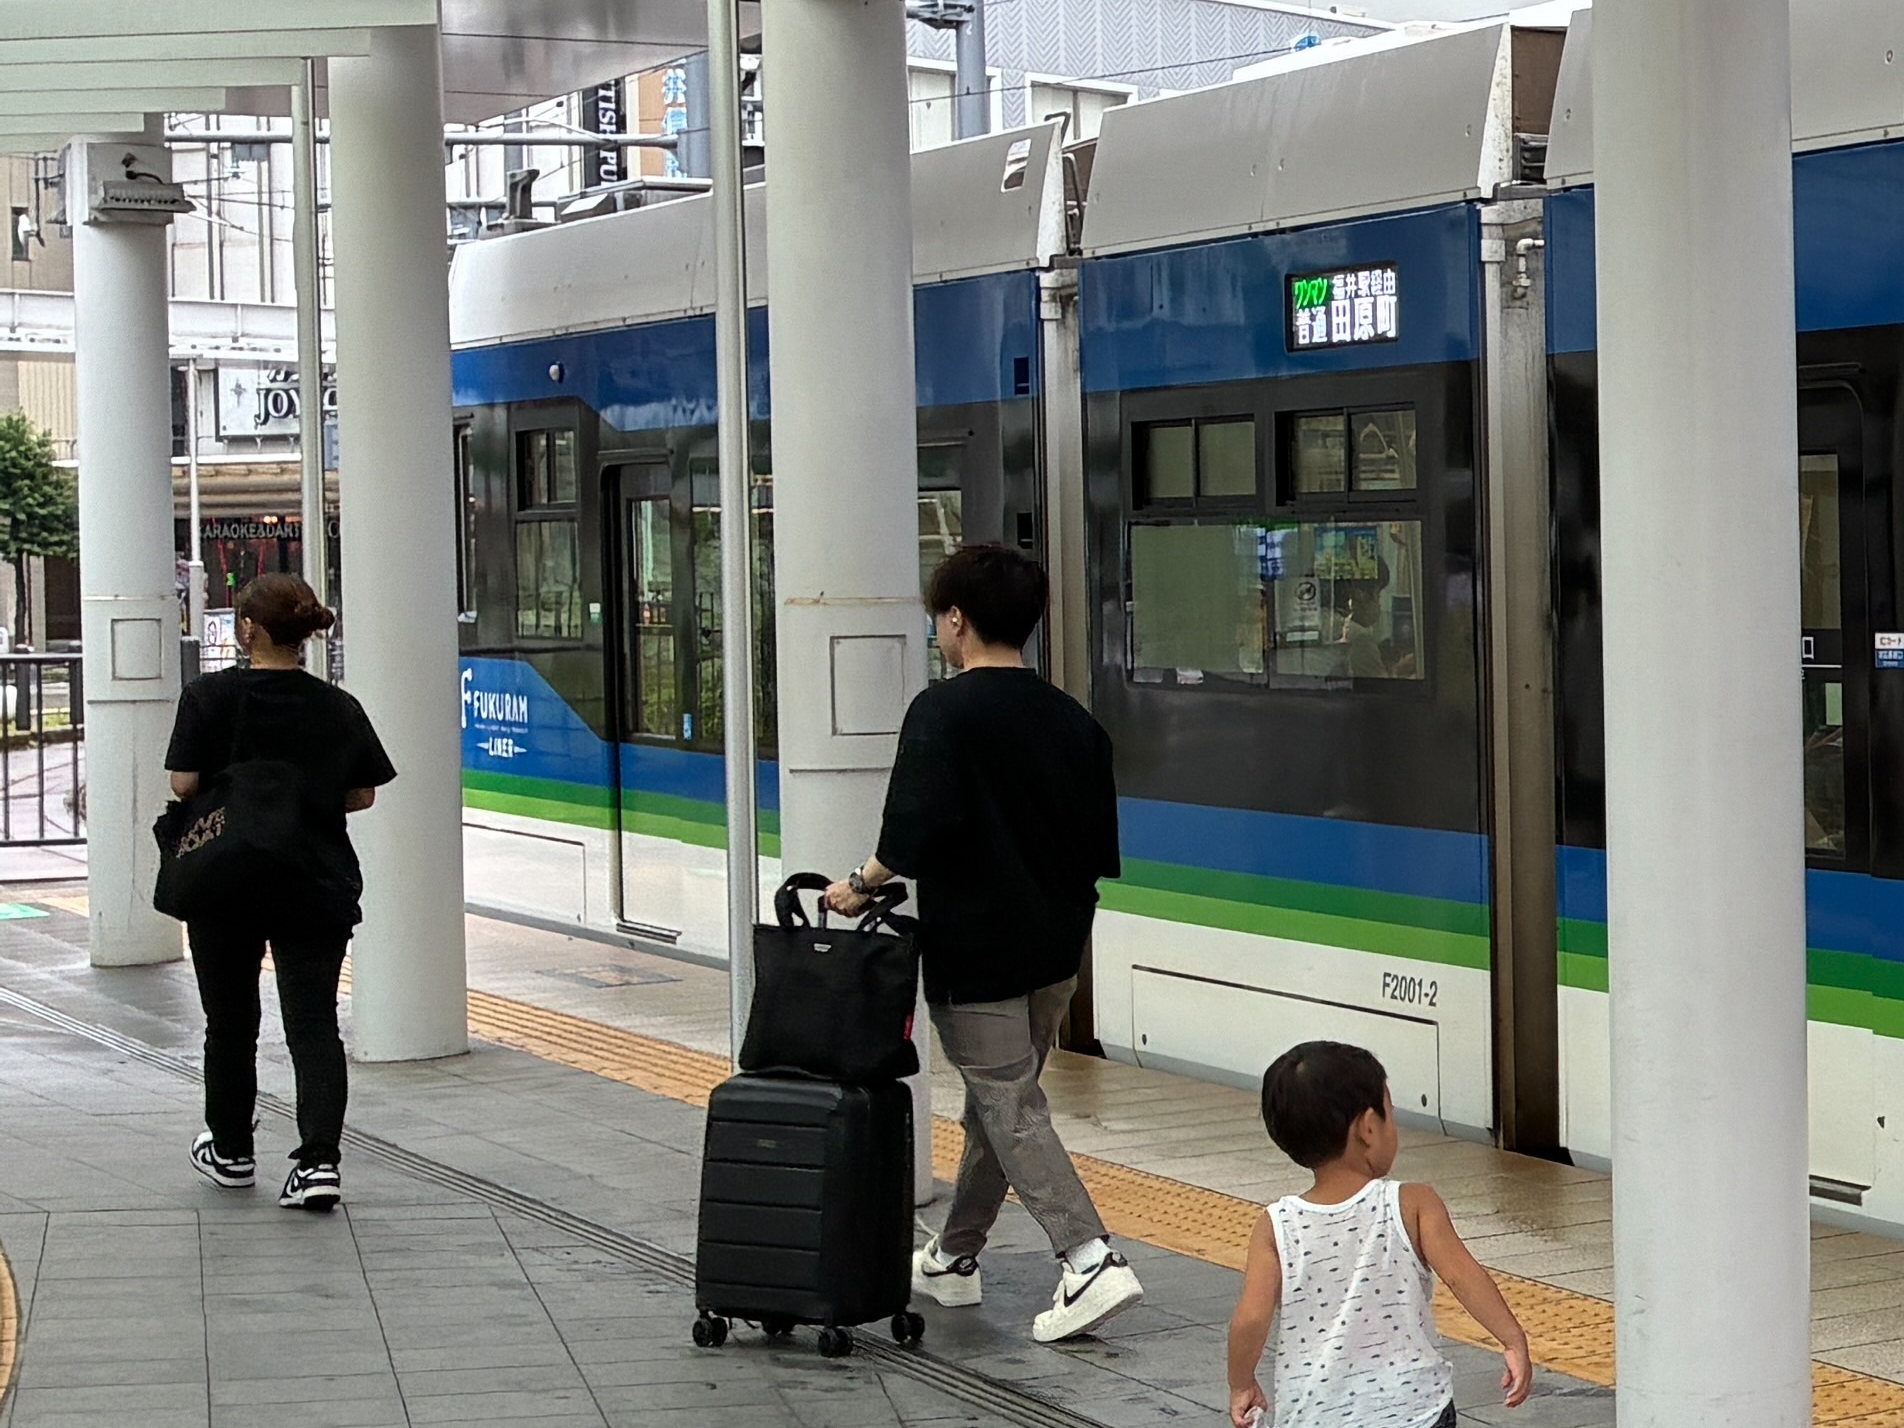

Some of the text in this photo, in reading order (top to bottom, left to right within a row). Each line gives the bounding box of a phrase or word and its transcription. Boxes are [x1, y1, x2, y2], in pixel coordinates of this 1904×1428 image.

[1296, 305, 1328, 344] 普通
[1331, 295, 1397, 342] 田原町
[1381, 971, 1439, 1009] F2001-2
